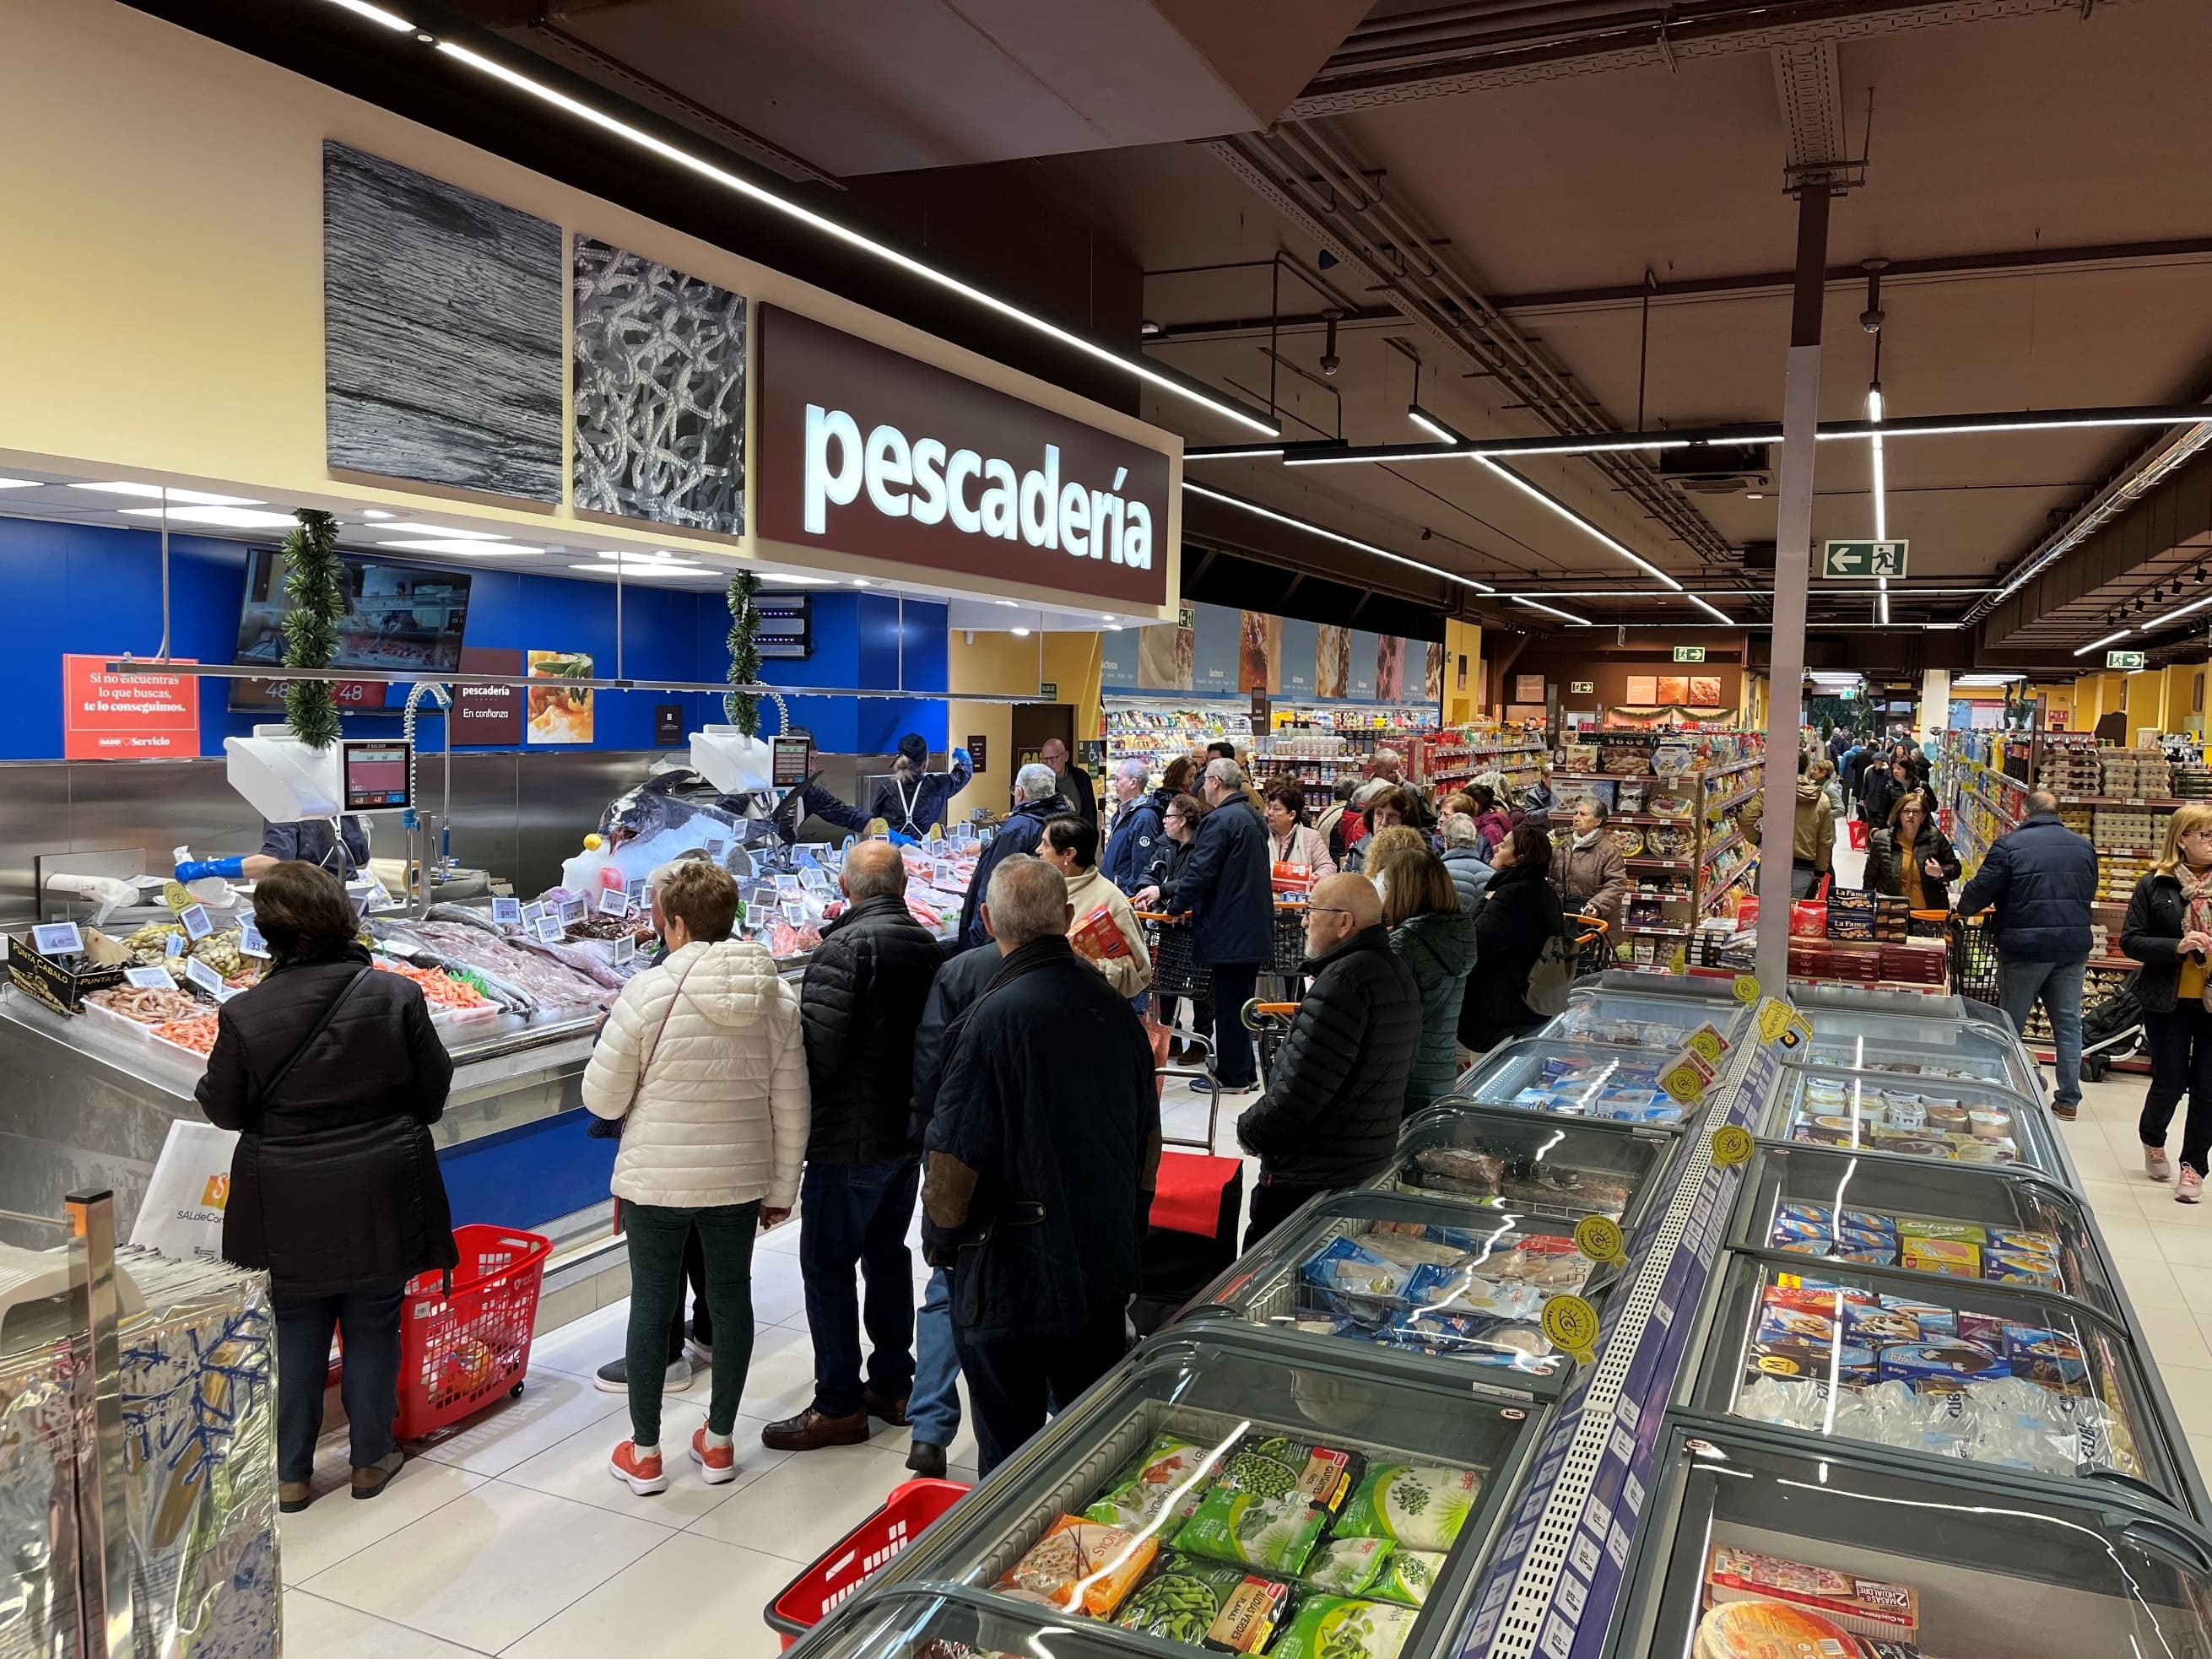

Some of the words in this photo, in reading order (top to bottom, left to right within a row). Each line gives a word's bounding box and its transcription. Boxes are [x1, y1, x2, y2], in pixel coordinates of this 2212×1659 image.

[804, 403, 1154, 570] pescadería
[90, 673, 101, 684] Si
[99, 687, 109, 697] lo
[112, 689, 131, 700] que
[134, 687, 171, 700] buscas,
[340, 685, 363, 701] 48
[462, 686, 510, 697] pescadería
[84, 702, 95, 711] te
[97, 701, 108, 711] lo
[111, 701, 187, 714] conseguimos.
[463, 709, 474, 718] En
[476, 708, 508, 718] confianza
[131, 737, 170, 746] Servicio
[1847, 889, 1868, 898] Fama
[13, 942, 36, 965] PUNTA
[36, 959, 68, 984] CABALO
[80, 975, 111, 986] PUNTA
[1766, 1012, 1782, 1035] NUEVO
[1546, 1306, 1570, 1345] #AhorroGadis
[1858, 1586, 1898, 1598] HOJALDRE
[1248, 1590, 1264, 1618] JUDÍAS
[1872, 1594, 1898, 1607] MASAS
[1228, 1596, 1245, 1622] PLANAS
[1230, 1615, 1252, 1642] VERDES
